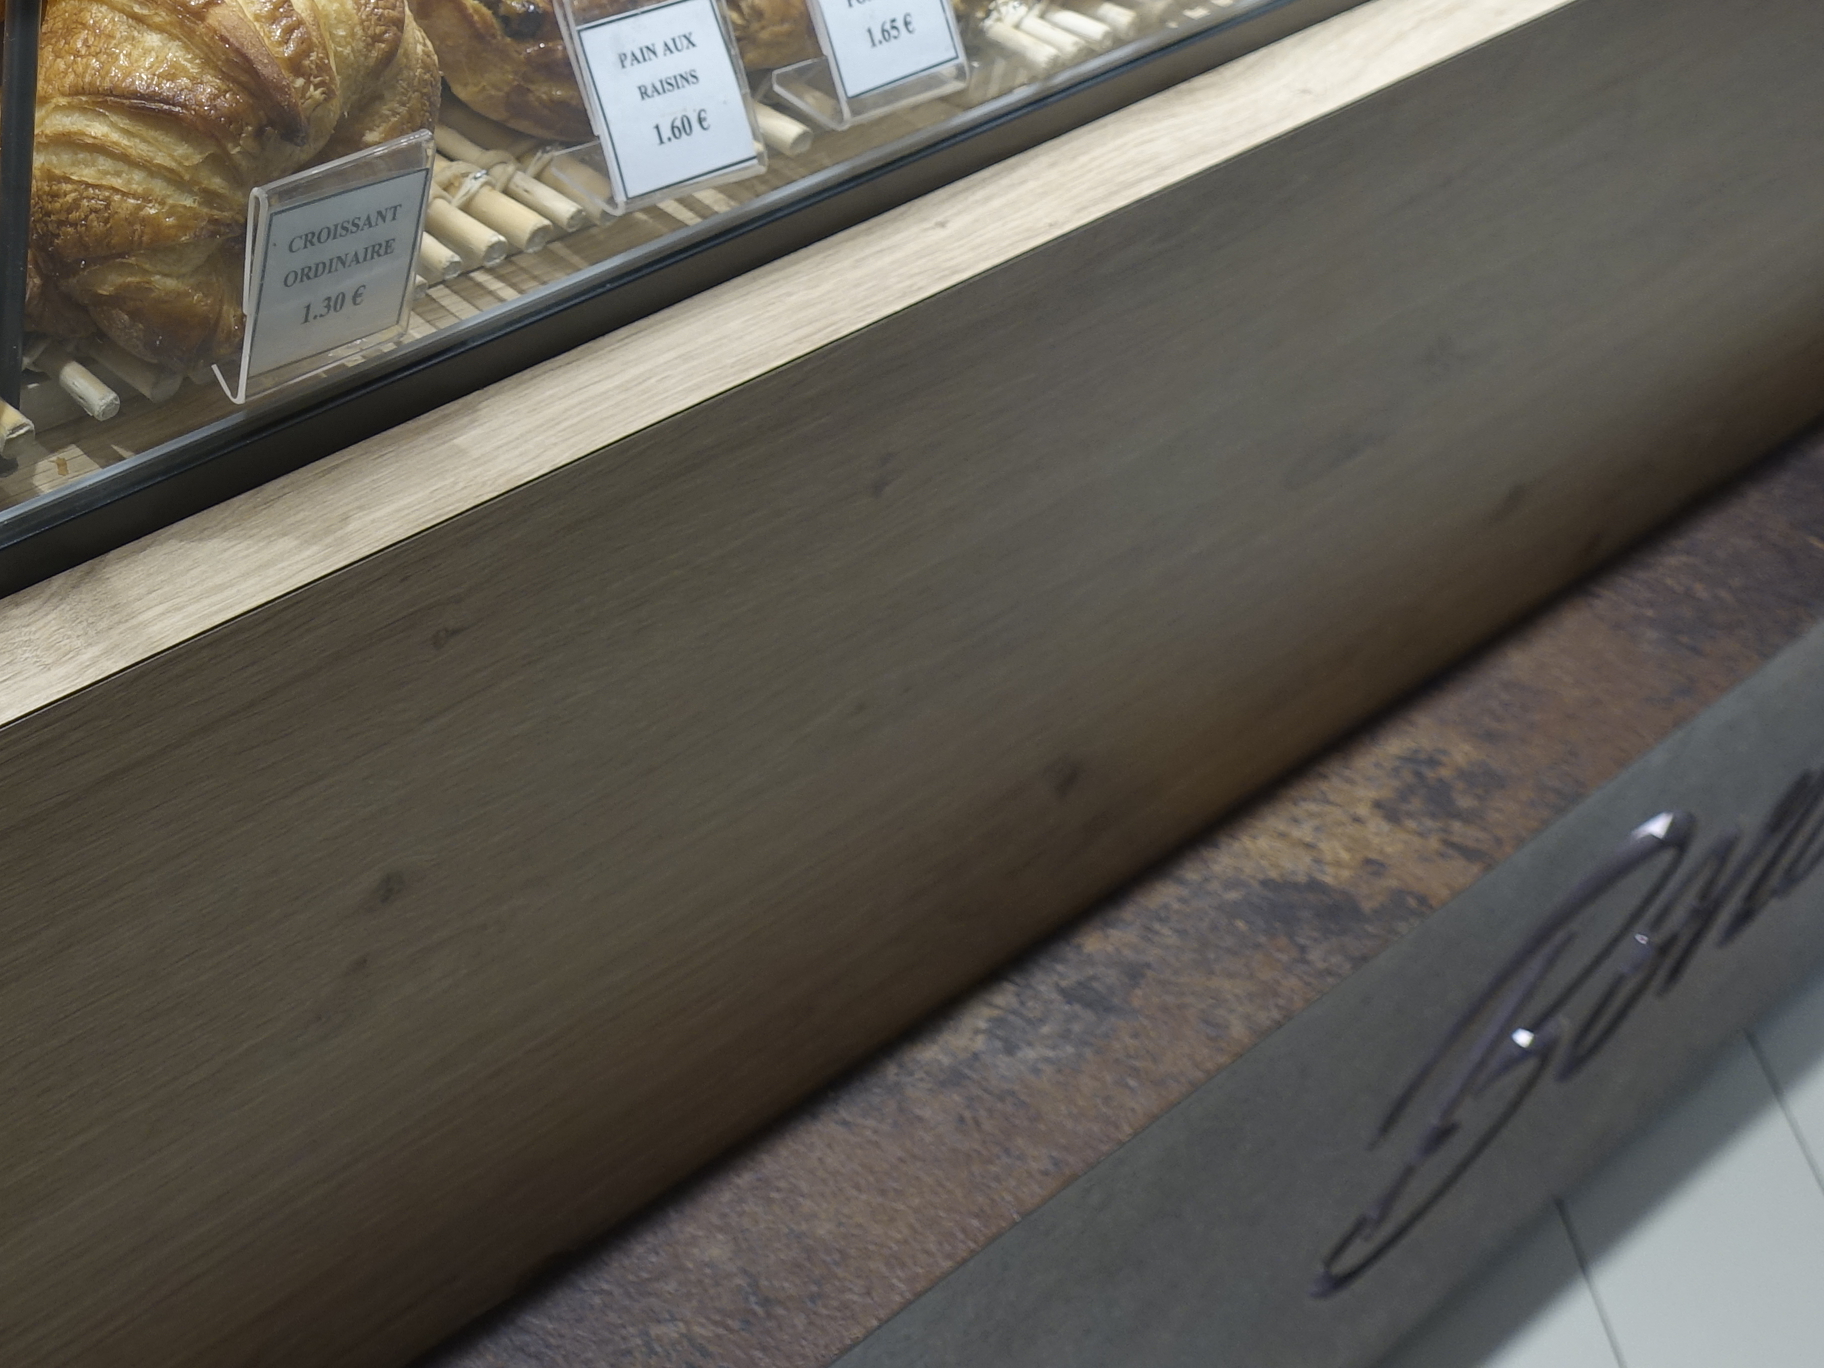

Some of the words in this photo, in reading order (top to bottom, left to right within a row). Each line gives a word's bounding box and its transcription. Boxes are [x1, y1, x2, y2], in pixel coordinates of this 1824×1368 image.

[866, 17, 901, 49] 1.65
[903, 12, 916, 34] €
[617, 44, 659, 69] PAIN
[662, 32, 697, 57] AUX
[637, 69, 699, 101] RAISINS
[652, 114, 693, 146] 1.60
[697, 109, 711, 131] €
[288, 204, 402, 254] CROISSANT
[283, 238, 396, 288] ORDINAIRE
[300, 294, 344, 325] 1.30
[351, 285, 366, 306] €
